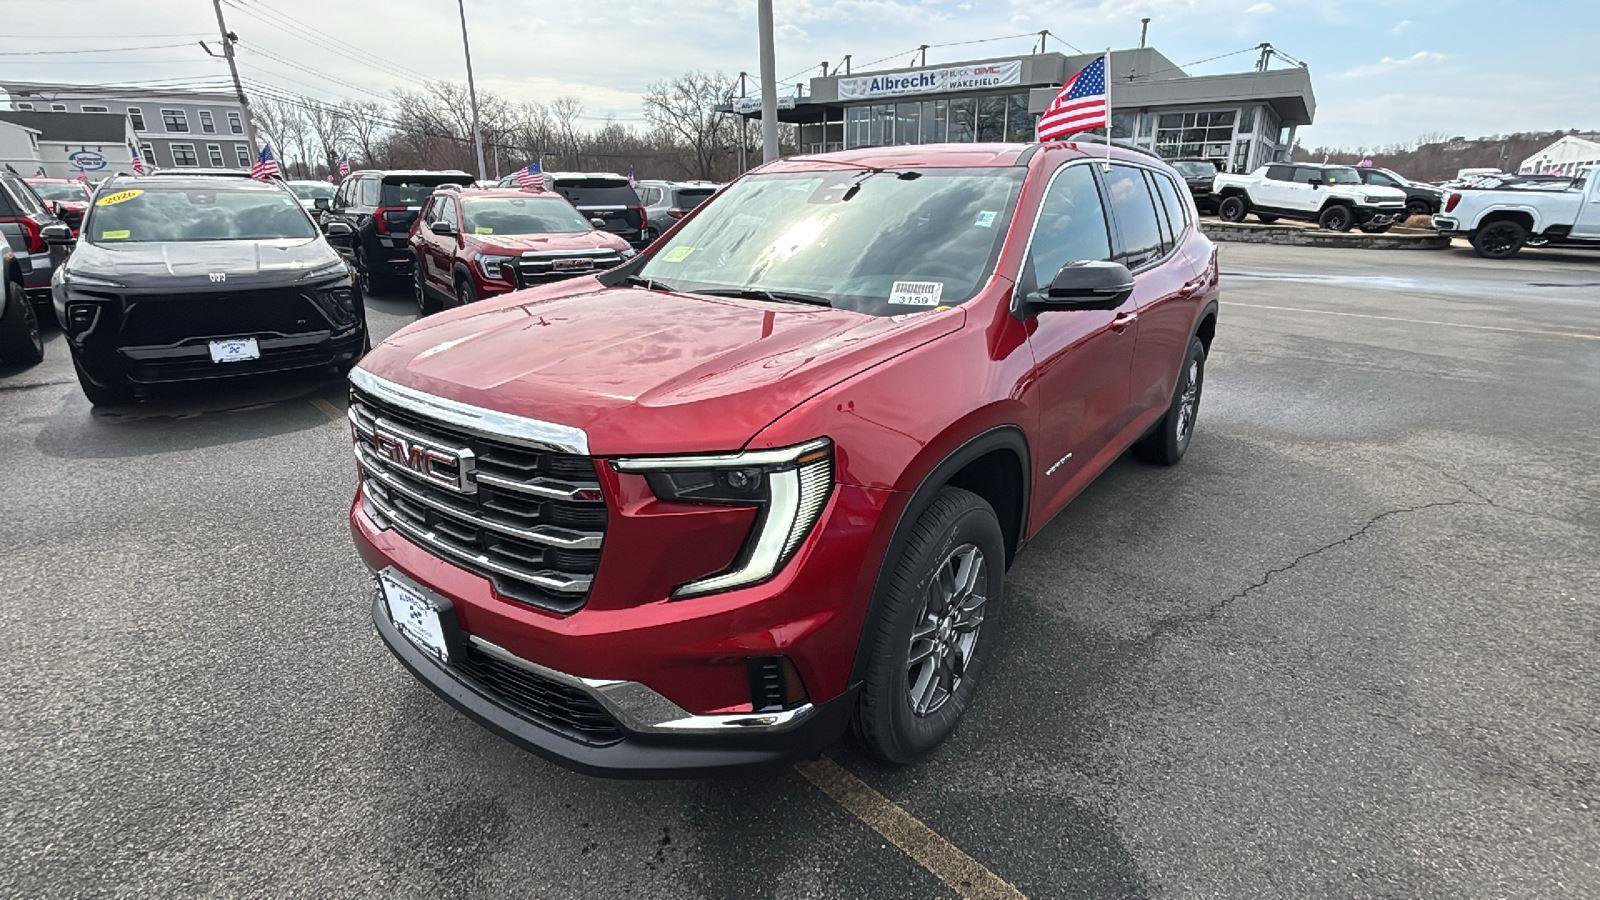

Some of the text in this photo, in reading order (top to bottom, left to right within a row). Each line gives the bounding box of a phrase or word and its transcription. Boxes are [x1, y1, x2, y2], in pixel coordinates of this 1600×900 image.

[870, 72, 936, 91] Albrecht
[949, 77, 999, 89] WAKEFIELD
[899, 296, 929, 304] 3159
[374, 429, 459, 486] GMC
